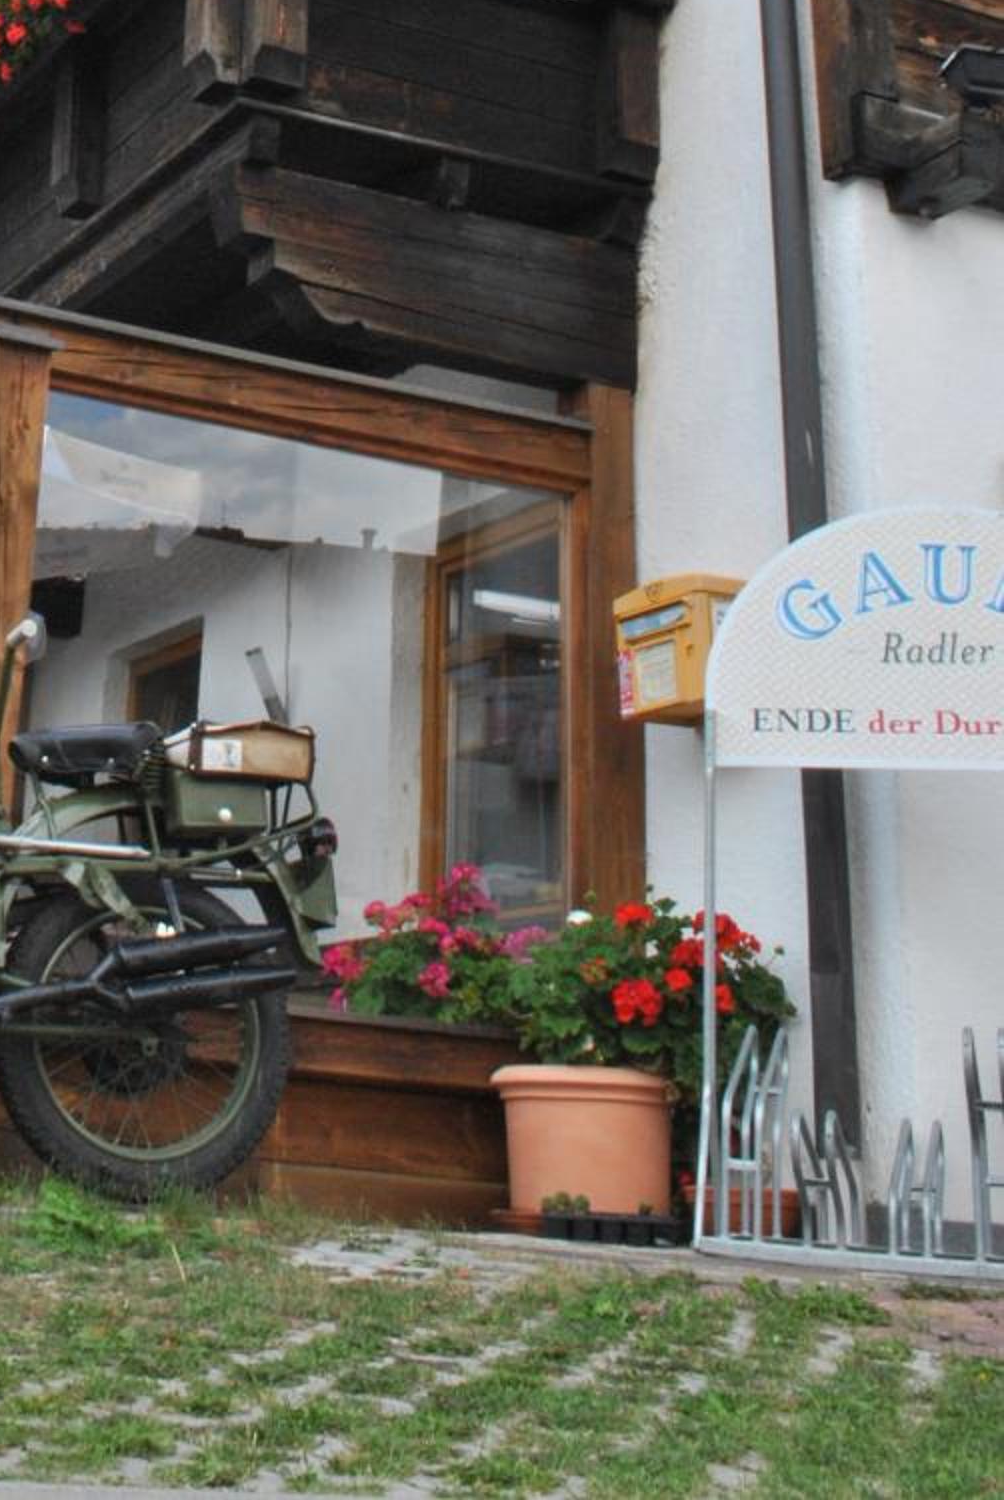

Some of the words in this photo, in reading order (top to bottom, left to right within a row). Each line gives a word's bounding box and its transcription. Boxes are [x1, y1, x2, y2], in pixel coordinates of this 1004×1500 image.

[881, 631, 995, 665] Radler
[752, 707, 856, 733] ENDE
[868, 708, 922, 735] der
[933, 708, 1003, 736] Dur
